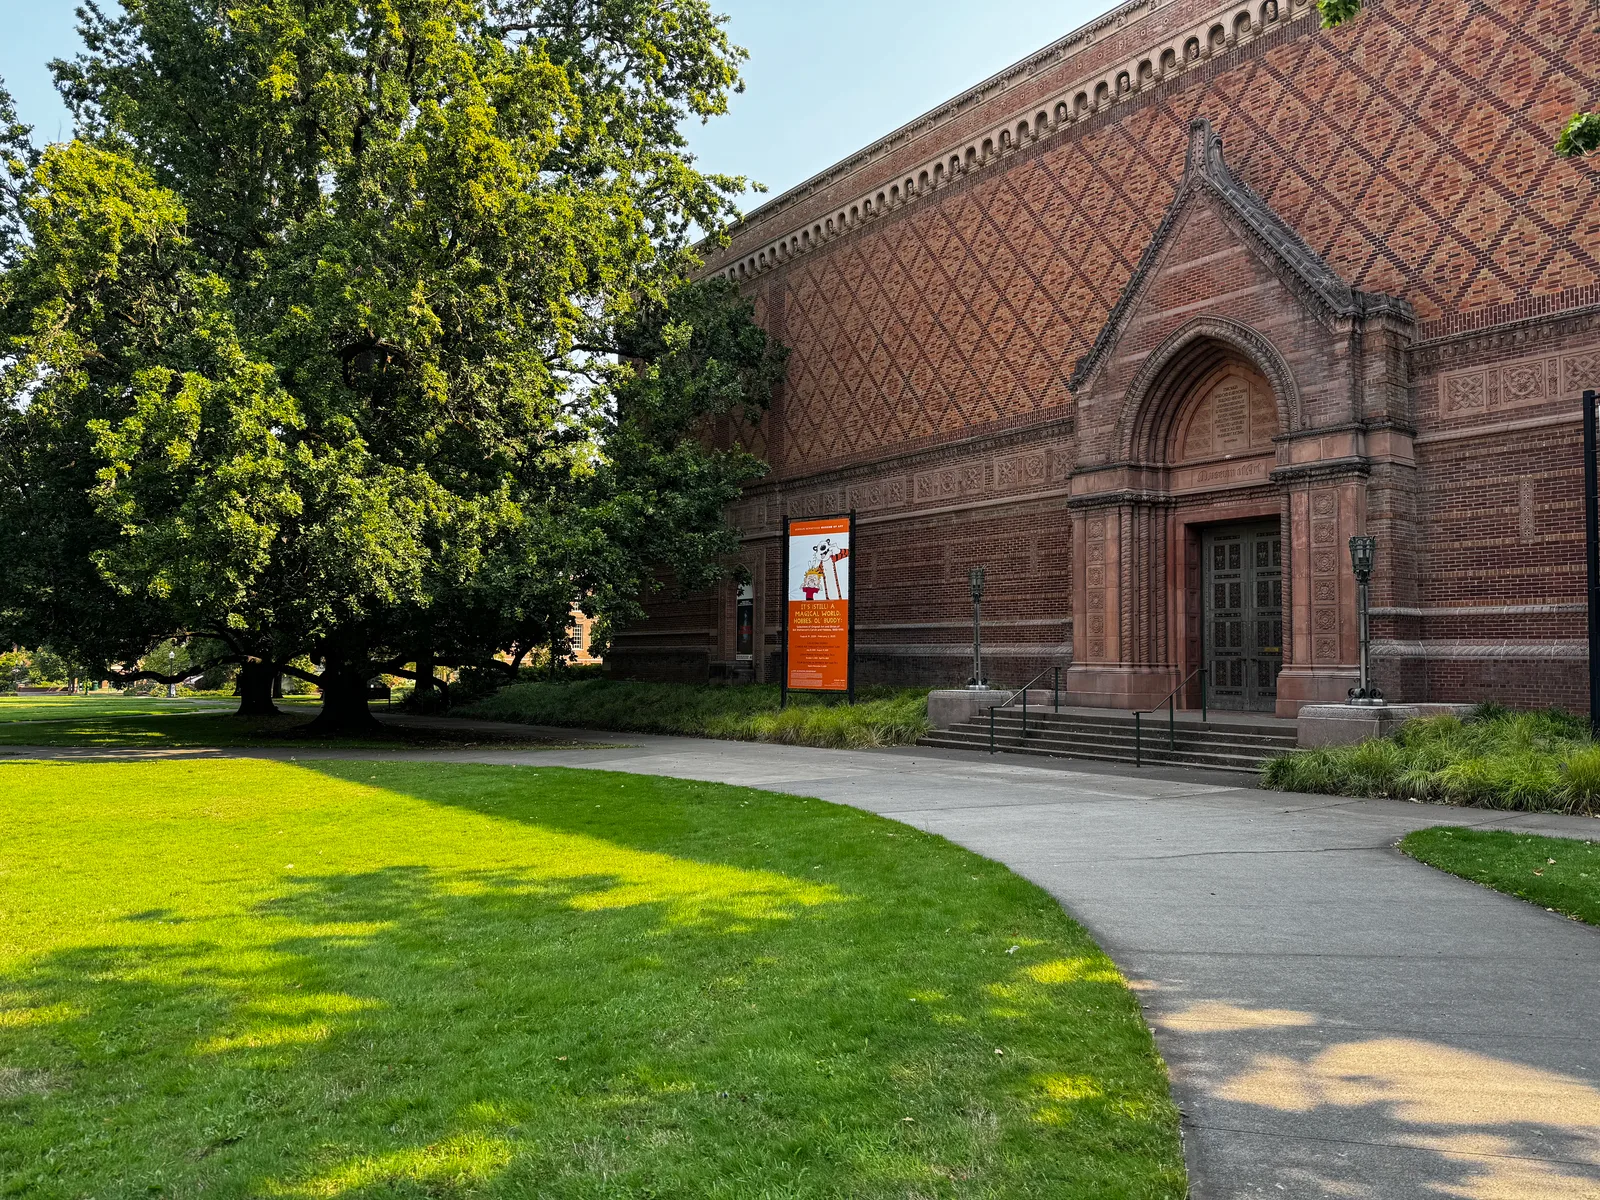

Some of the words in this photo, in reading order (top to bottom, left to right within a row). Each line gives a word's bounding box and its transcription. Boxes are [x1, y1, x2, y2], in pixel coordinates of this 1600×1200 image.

[1197, 468, 1236, 482] Museum
[1236, 464, 1246, 476] of
[1246, 463, 1261, 476] Art
